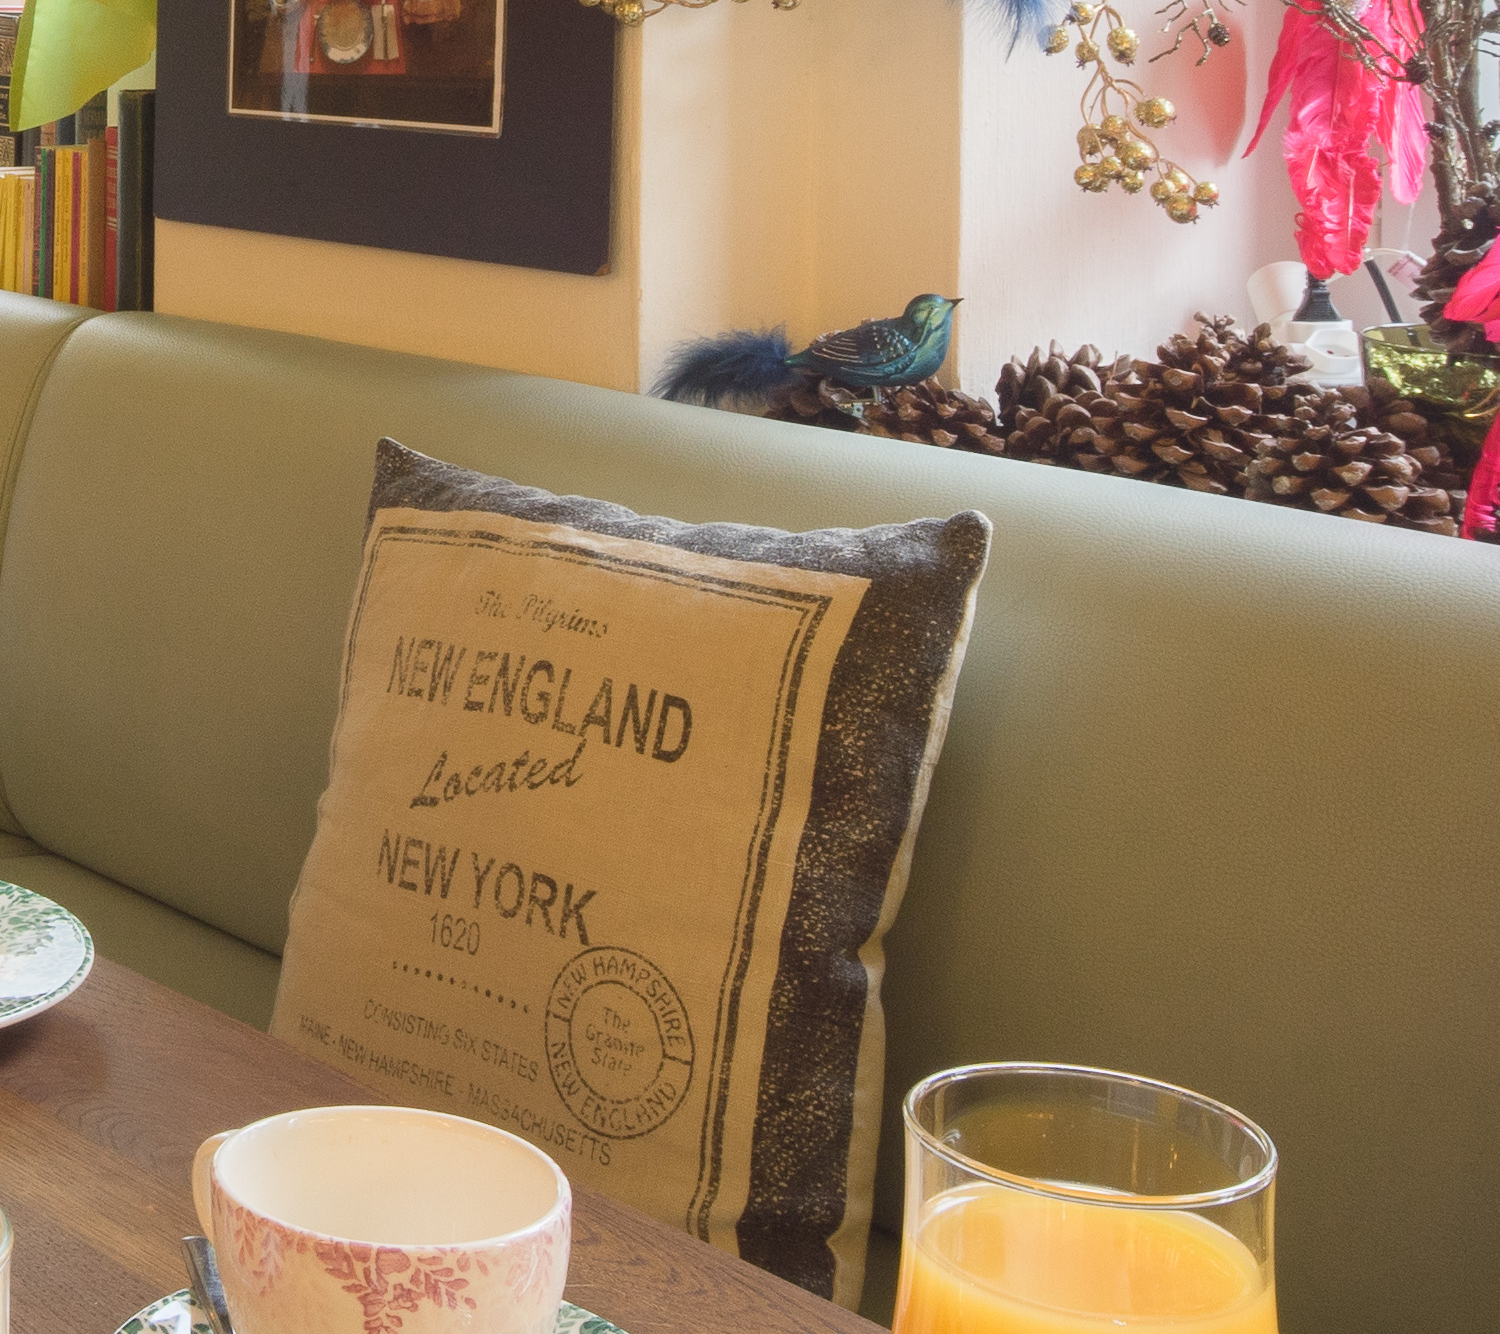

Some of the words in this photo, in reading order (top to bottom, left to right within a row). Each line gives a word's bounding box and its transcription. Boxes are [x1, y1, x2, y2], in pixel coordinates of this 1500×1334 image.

[515, 593, 608, 638] Pilgrims
[386, 635, 467, 706] NEW
[463, 650, 694, 764] ENGLAND
[409, 737, 587, 809] Located
[376, 828, 461, 899] NEW
[471, 851, 598, 947] YORK
[430, 910, 481, 955] 1620
[364, 998, 450, 1046] CONSISTING
[481, 1040, 540, 1083] STATES
[557, 964, 587, 1009] NEW
[592, 956, 686, 1047] HAMPSHIRE
[338, 1033, 367, 1066] NEW
[368, 1051, 455, 1097] HAMPSHIRE
[468, 1082, 611, 1166] MASSACHUSETTS
